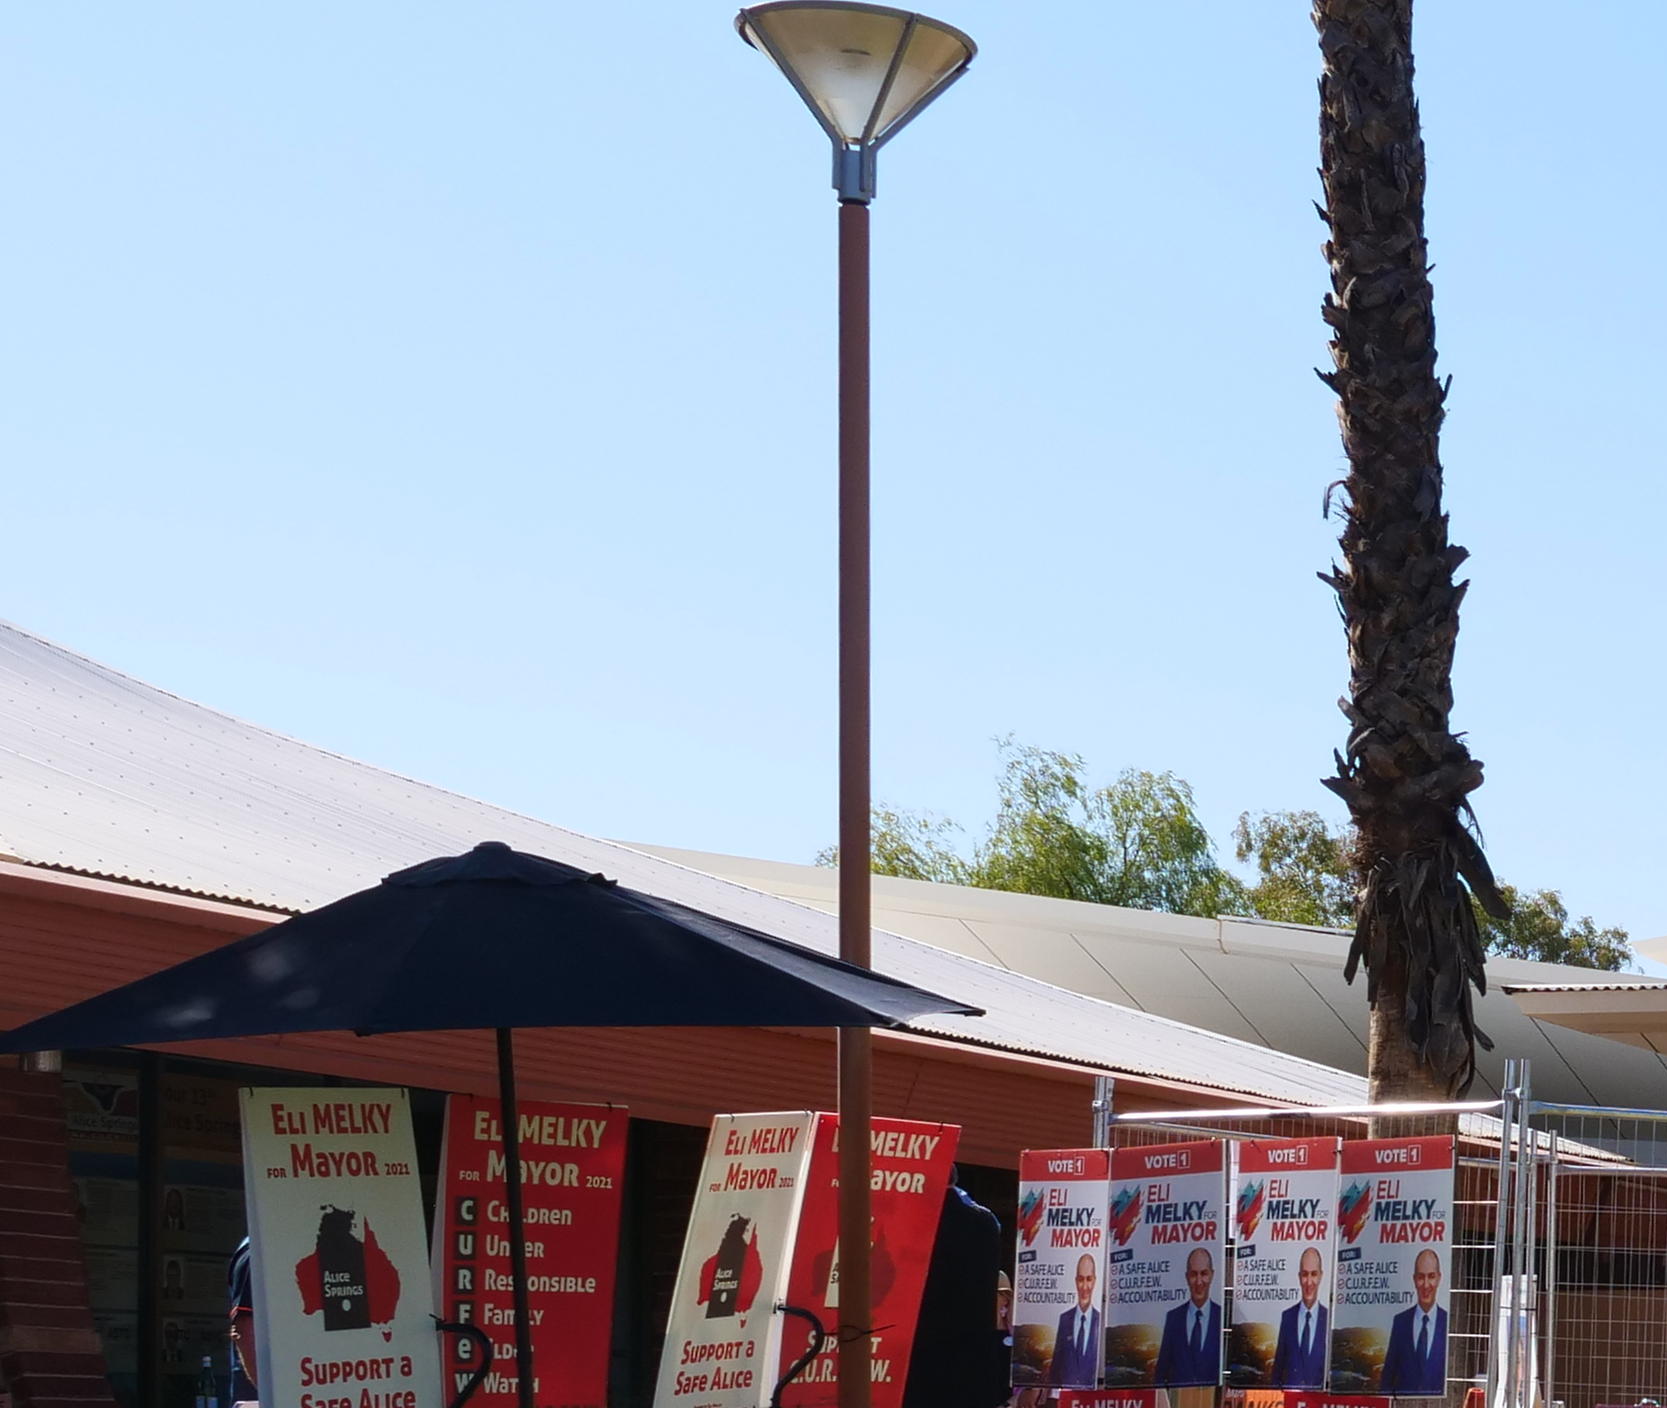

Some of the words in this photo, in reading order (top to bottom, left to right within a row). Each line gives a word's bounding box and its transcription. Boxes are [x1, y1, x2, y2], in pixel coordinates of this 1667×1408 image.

[312, 1103, 392, 1134] MELKY
[518, 1114, 607, 1148] MELKY
[750, 1127, 800, 1154] MELKY
[1048, 1159, 1074, 1173] VOTE
[1144, 1154, 1176, 1169] VOTE
[1268, 1150, 1296, 1164] VOTE
[1375, 1149, 1407, 1164] VOTE
[384, 1163, 410, 1176] 2021
[586, 1176, 613, 1189] 2021
[1269, 1179, 1289, 1198] ELI
[1377, 1180, 1400, 1199] ELI
[1048, 1188, 1068, 1207] ELI
[1148, 1183, 1170, 1202] ELI
[1047, 1208, 1094, 1226] MELKY
[1146, 1200, 1207, 1224] MELKY
[1267, 1199, 1320, 1220] MELKY
[1374, 1199, 1436, 1222] MELKY
[1051, 1228, 1100, 1248] MAYOR
[1151, 1220, 1217, 1244] MAYOR
[1271, 1220, 1328, 1241] MAYOR
[1380, 1221, 1446, 1244] MAYOR
[1127, 1262, 1148, 1274] SAFE
[1149, 1261, 1170, 1272] ALICE
[1252, 1260, 1268, 1271] SAFE
[1268, 1259, 1286, 1270] ALICE
[1355, 1261, 1374, 1273] SAFE
[1374, 1261, 1398, 1273] ALICE
[458, 1268, 472, 1290] R
[1118, 1288, 1188, 1303] ACCOUNTABILITY
[1243, 1288, 1299, 1300] ACCOUNTABILITY
[1344, 1291, 1416, 1304] ACCOUNTABILITY
